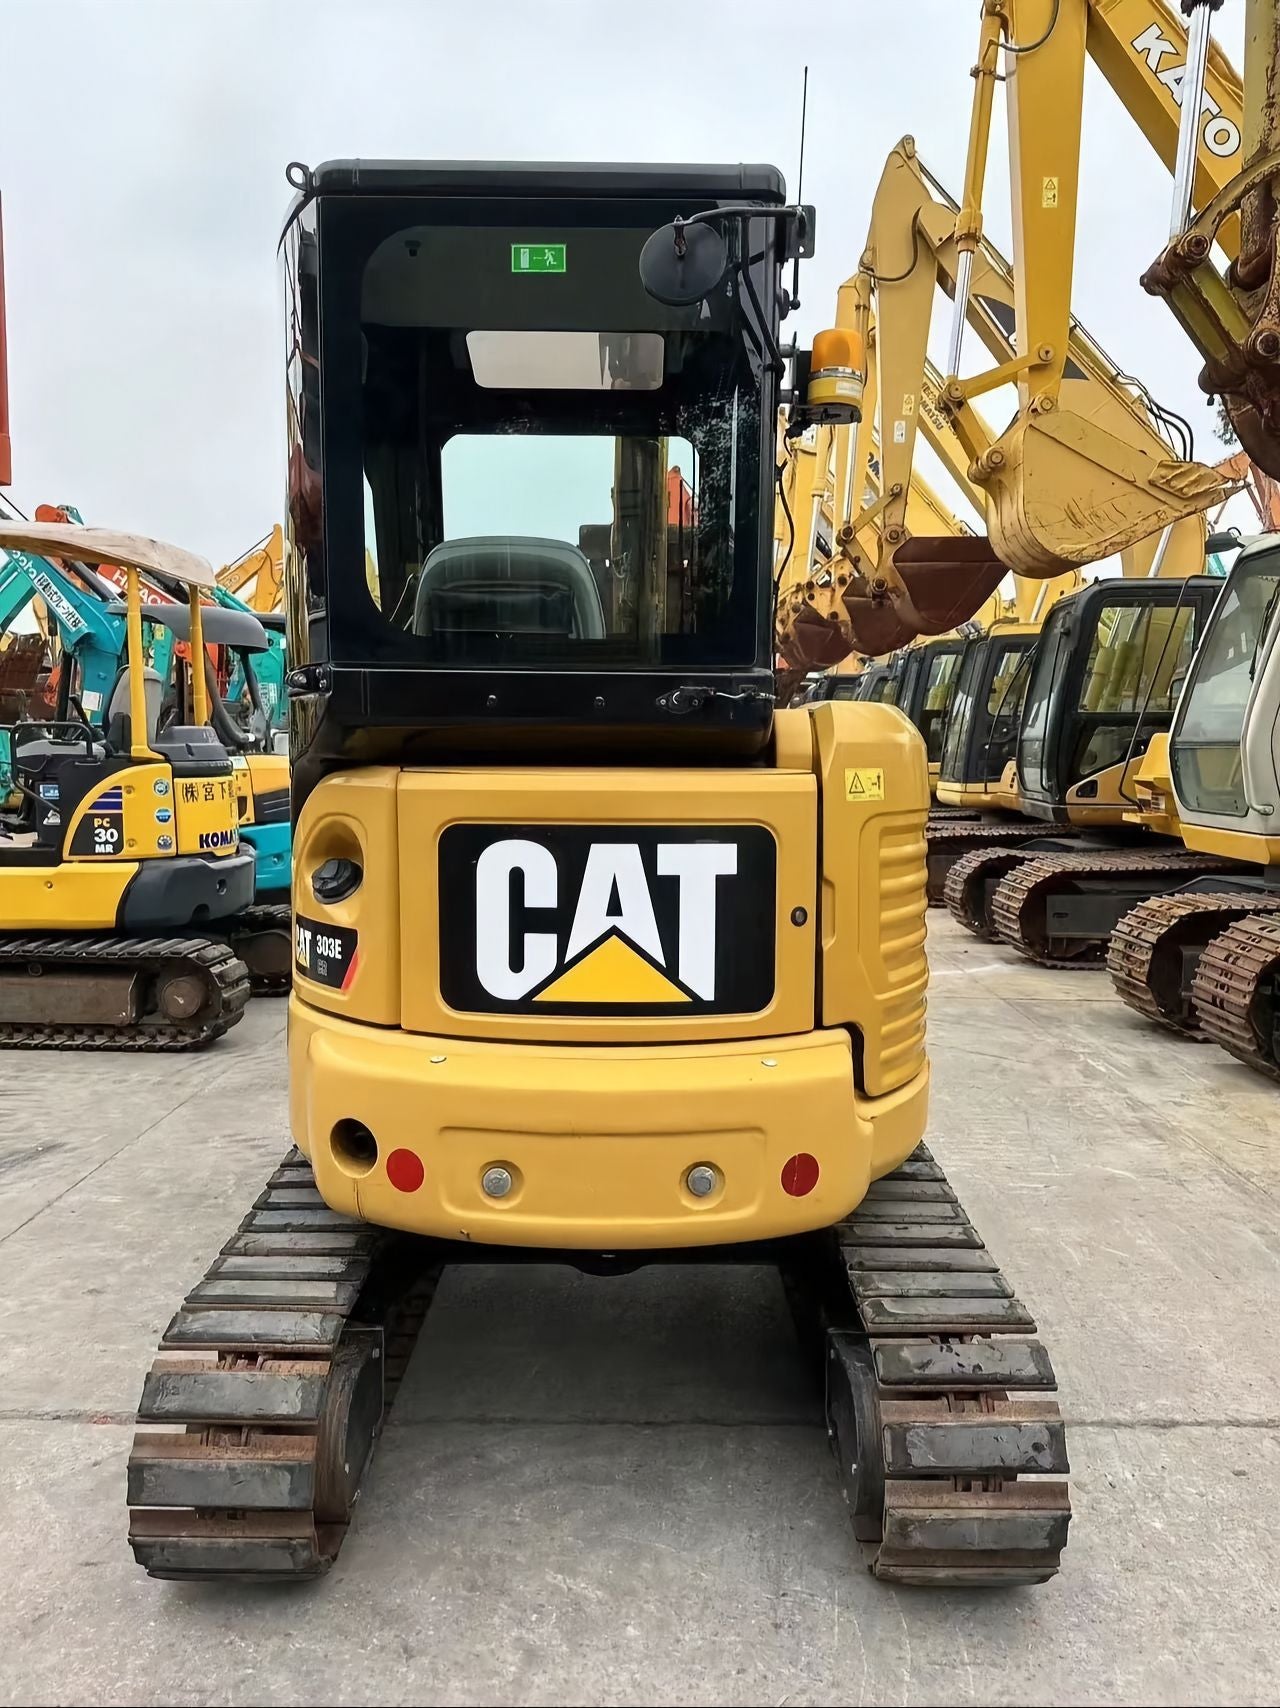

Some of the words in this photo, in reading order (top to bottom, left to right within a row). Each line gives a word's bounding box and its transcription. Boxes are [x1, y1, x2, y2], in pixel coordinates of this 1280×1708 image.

[94, 818, 110, 828] PC
[94, 829, 118, 842] 30
[199, 828, 238, 849] KOMA
[95, 844, 113, 853] MR
[476, 839, 738, 1001] CAT
[316, 935, 342, 960] 303E
